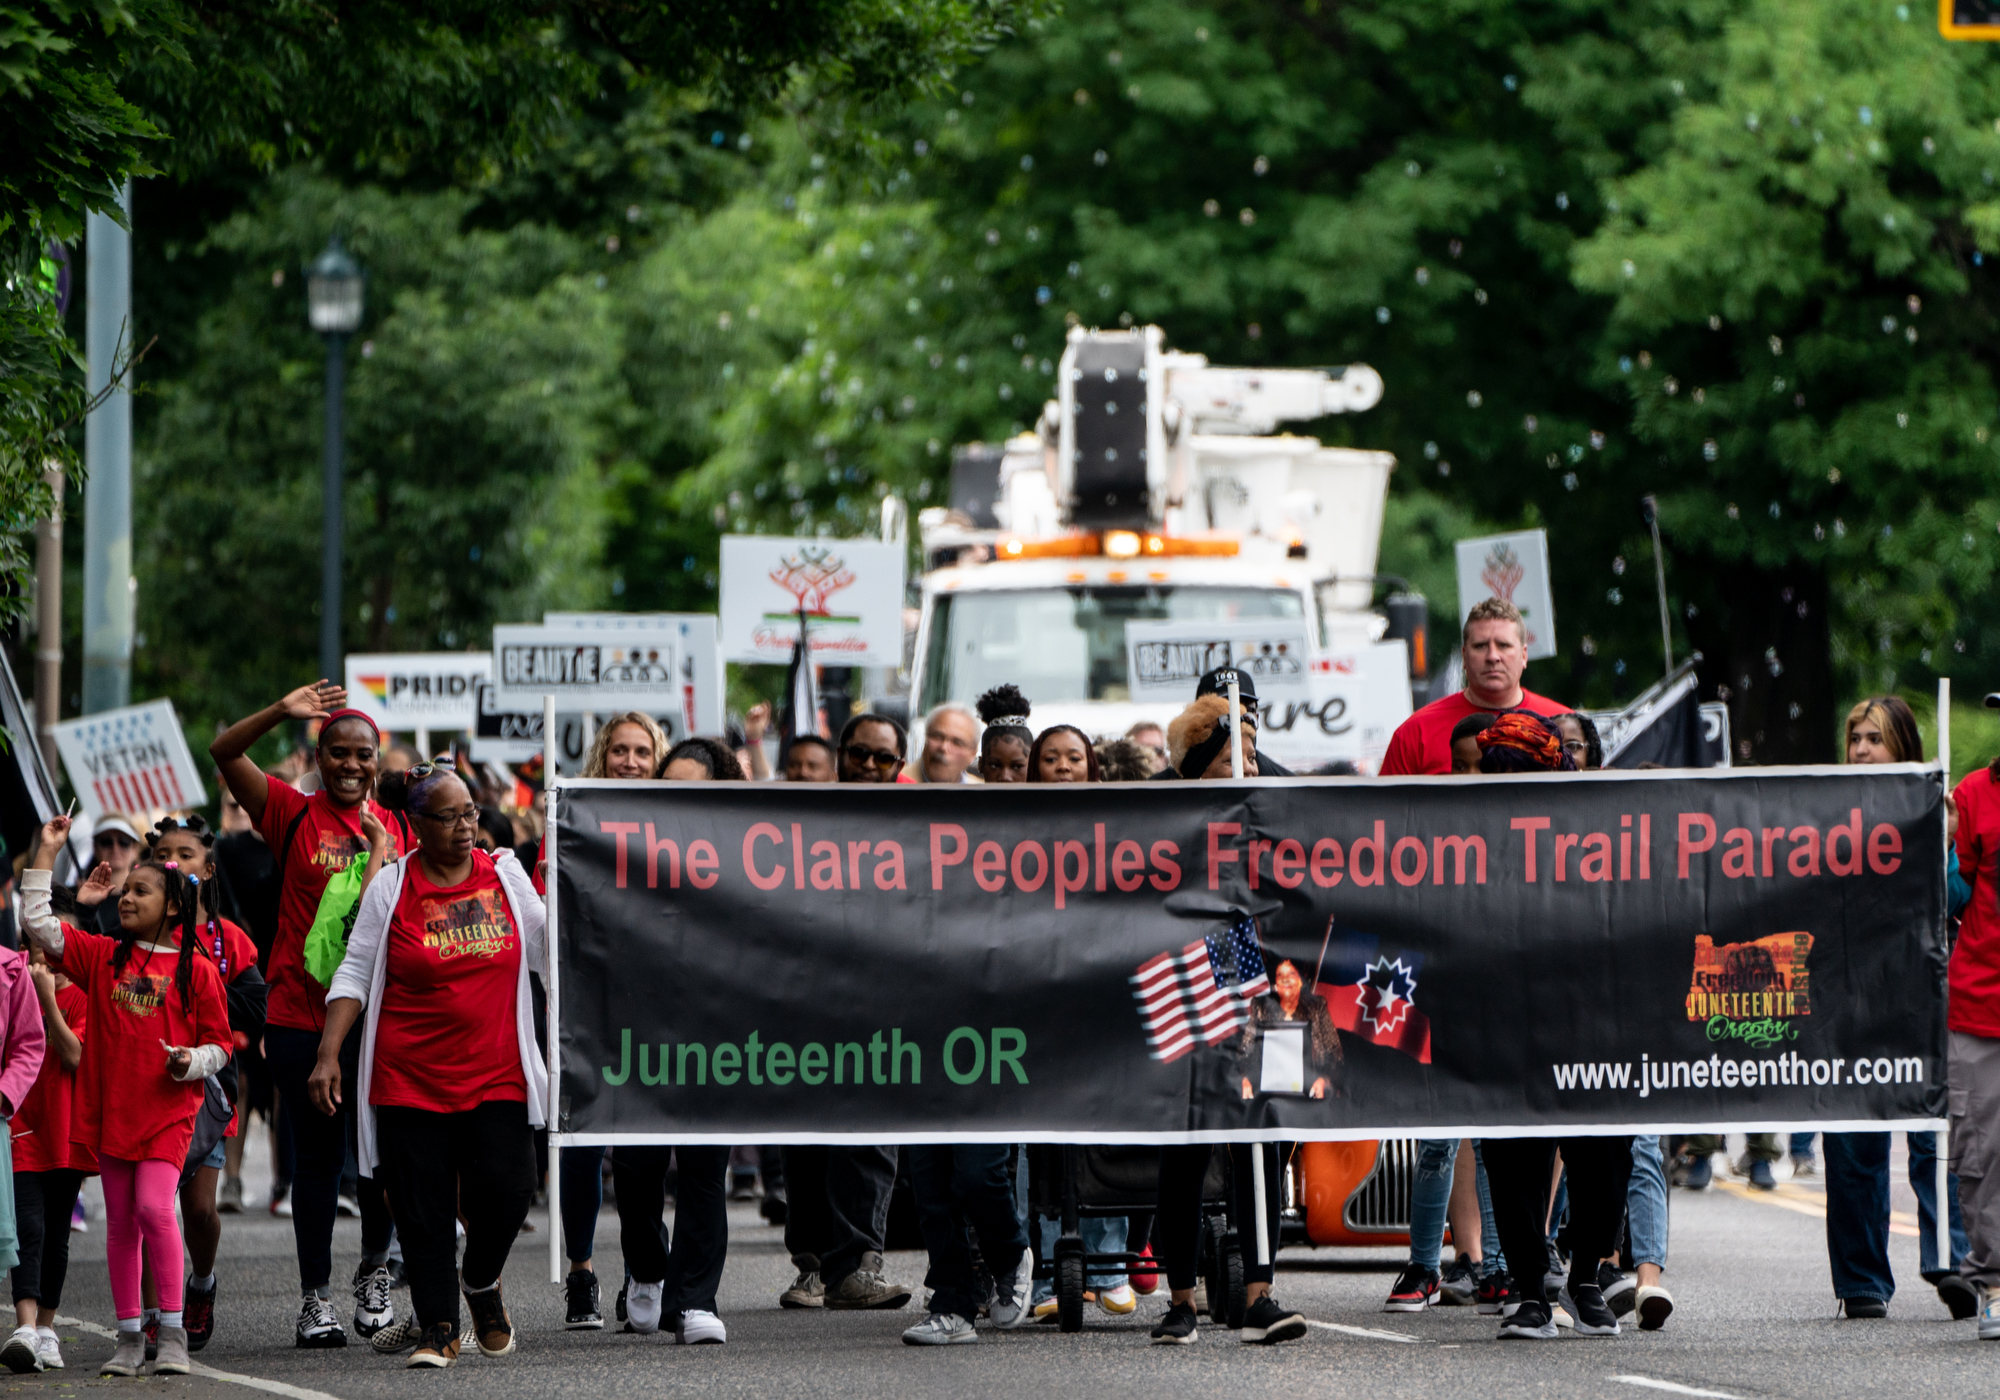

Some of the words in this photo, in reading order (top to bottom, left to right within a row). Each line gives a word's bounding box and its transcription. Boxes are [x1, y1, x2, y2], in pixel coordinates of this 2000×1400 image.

[601, 822, 719, 889] The
[743, 823, 906, 890] Clara
[930, 823, 1181, 909] Peoples
[1208, 820, 1487, 889] Freedom
[1511, 814, 1650, 882] Trail
[1678, 808, 1902, 878] Parade
[423, 923, 505, 947] JUNETEENTH
[1687, 991, 1795, 1017] JUNETEENTH
[1706, 1014, 1799, 1049] Oregon
[603, 1029, 920, 1086] Juneteenth
[944, 1027, 1029, 1085] OR
[1553, 1052, 1924, 1098] www.juneteenthor.com
